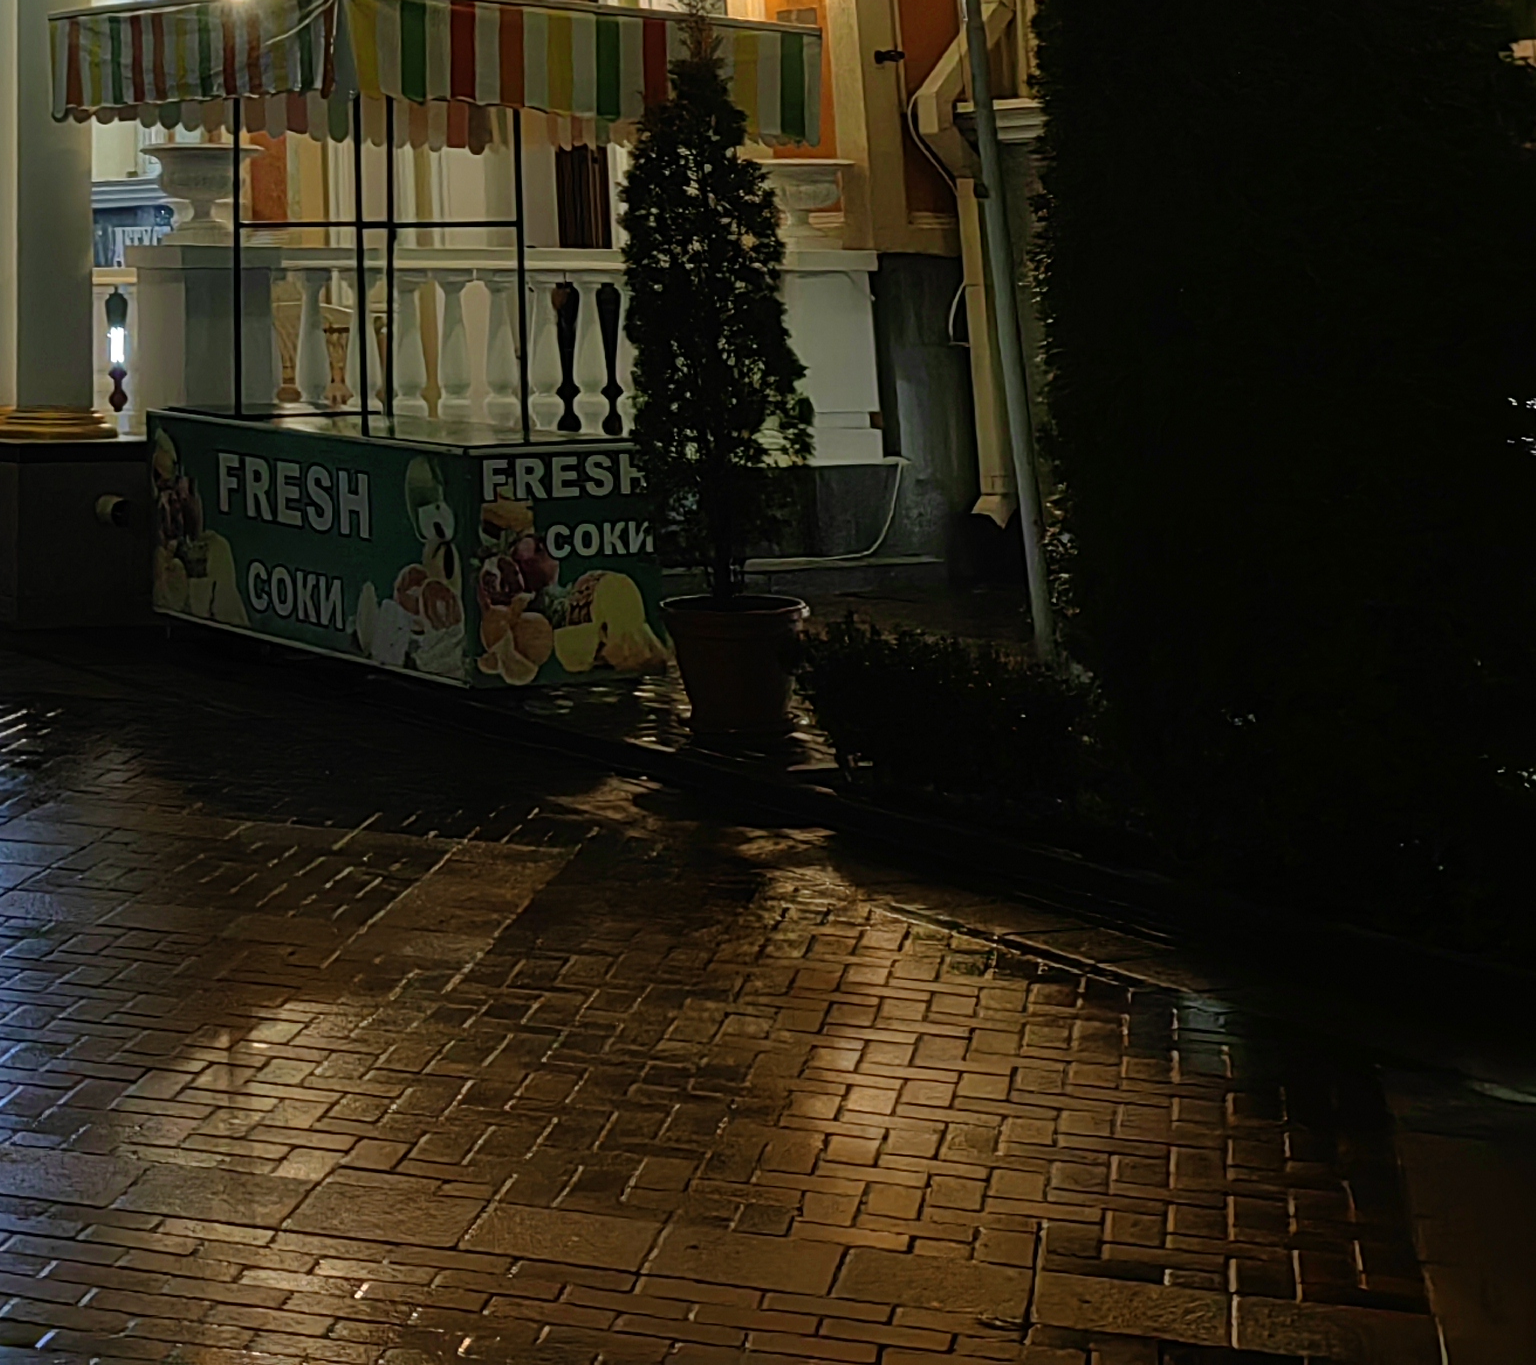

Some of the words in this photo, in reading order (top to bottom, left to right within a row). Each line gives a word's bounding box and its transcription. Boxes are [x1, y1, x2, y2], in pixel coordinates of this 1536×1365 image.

[218, 452, 370, 540] FRESH
[546, 521, 655, 558] СОКИ
[248, 561, 344, 630] СОКИ
